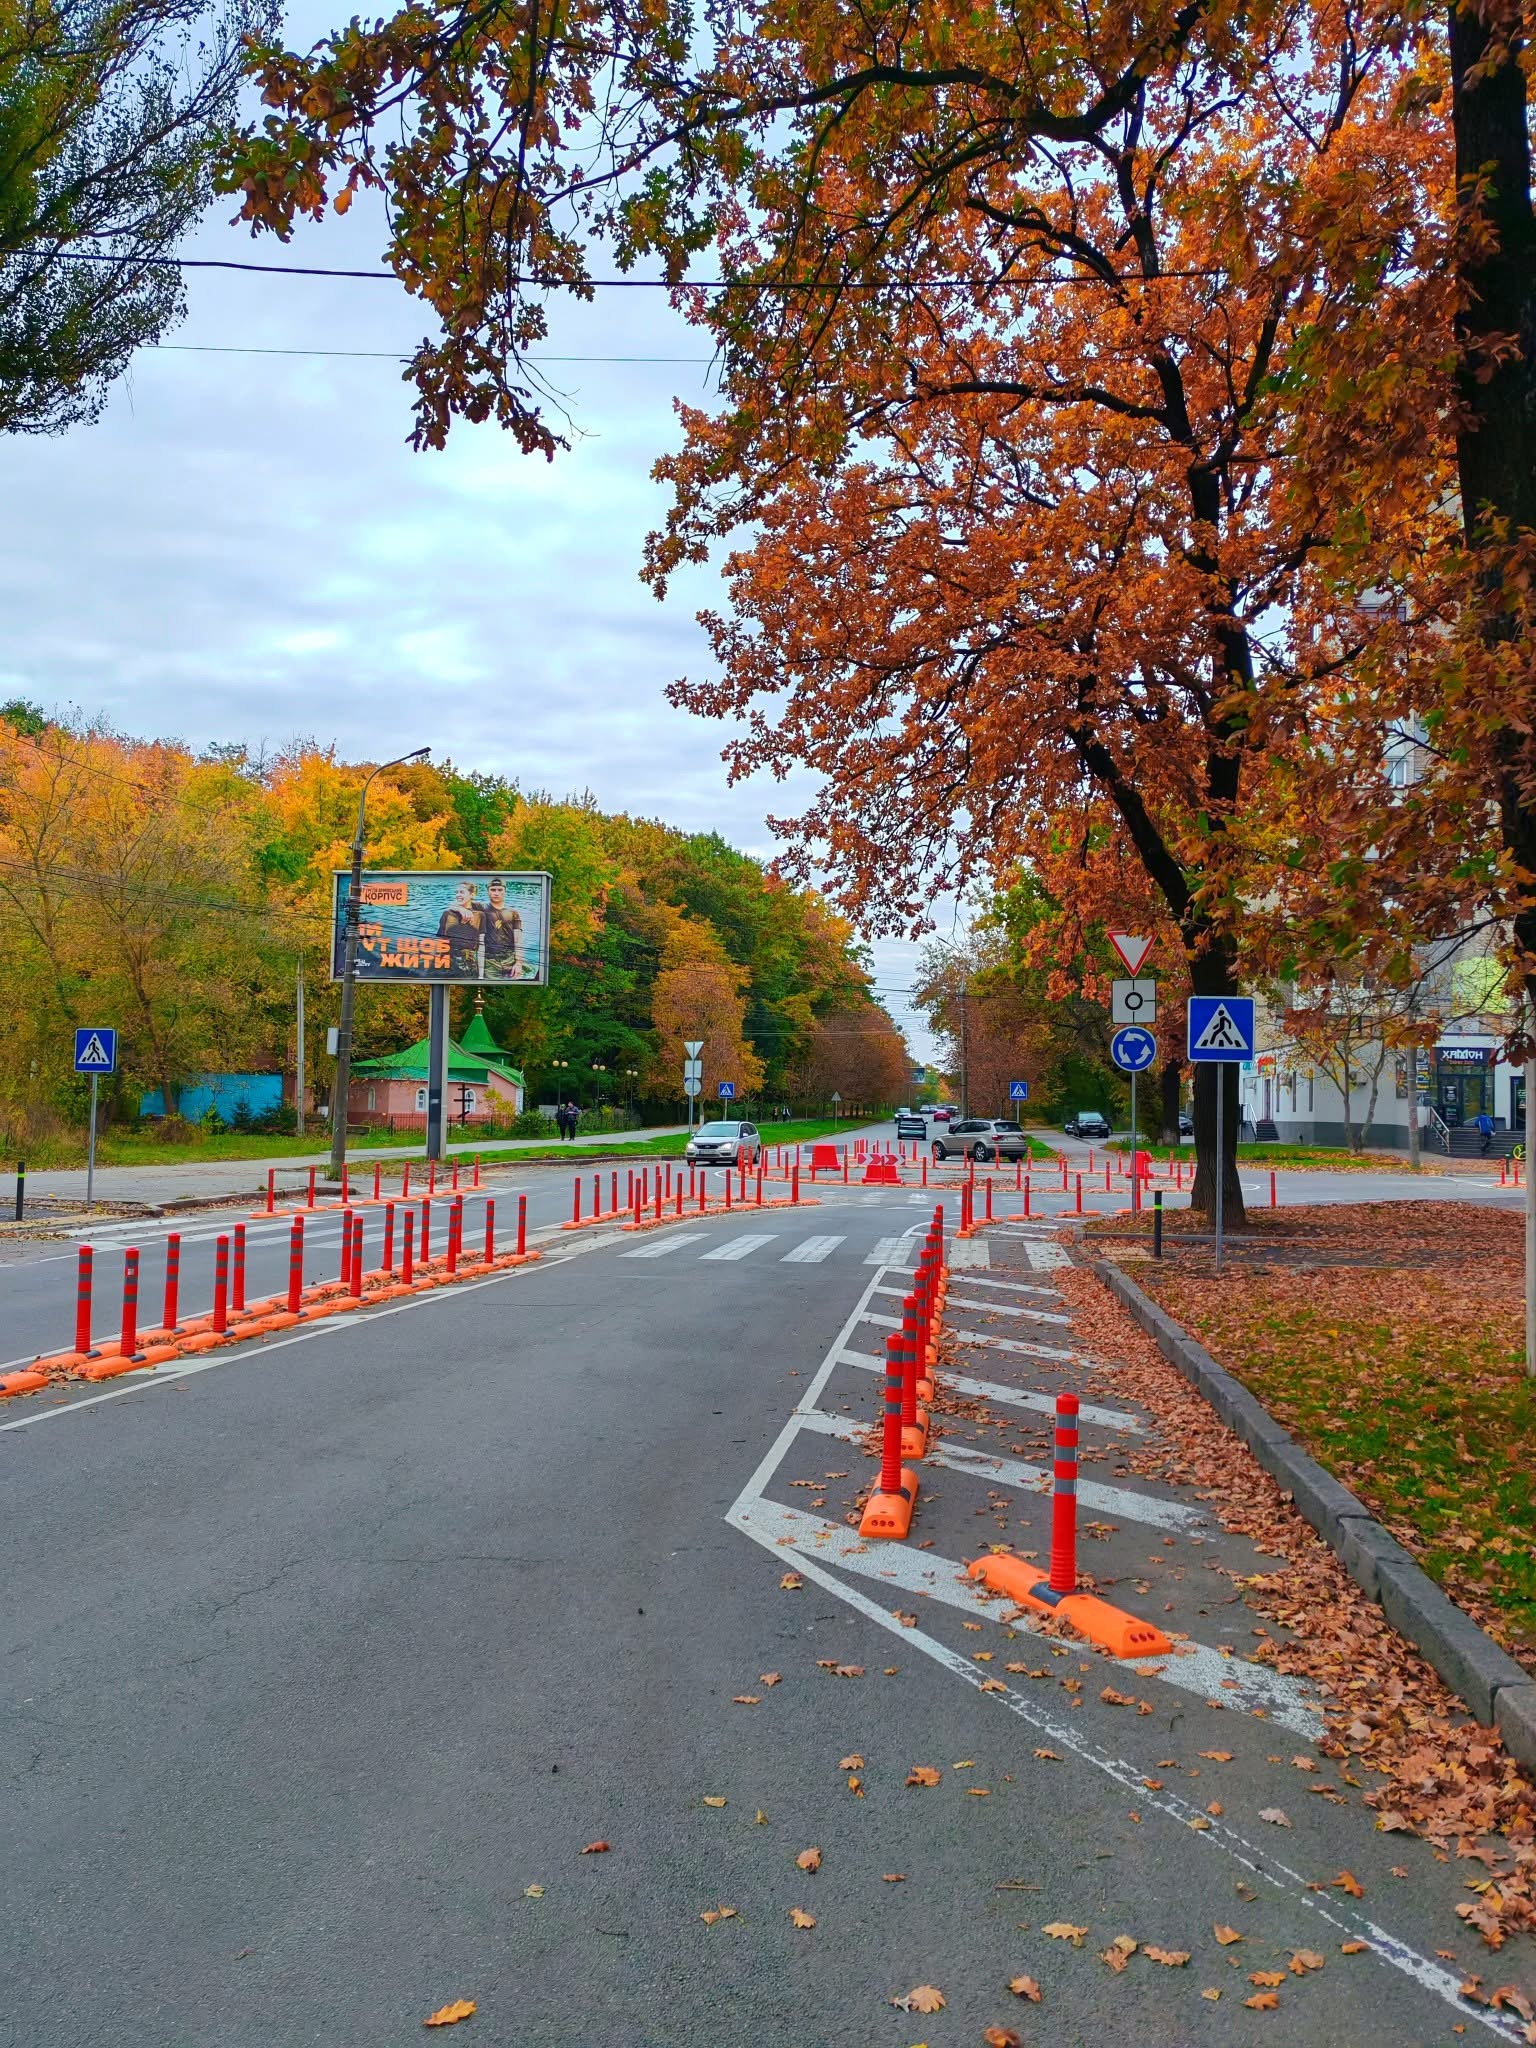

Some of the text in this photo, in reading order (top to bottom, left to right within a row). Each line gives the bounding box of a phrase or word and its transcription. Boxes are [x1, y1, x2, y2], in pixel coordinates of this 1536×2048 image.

[365, 892, 402, 901] КОРПУС
[359, 937, 451, 952] УТ ЩОБ
[380, 953, 451, 969] ЖИТИ
